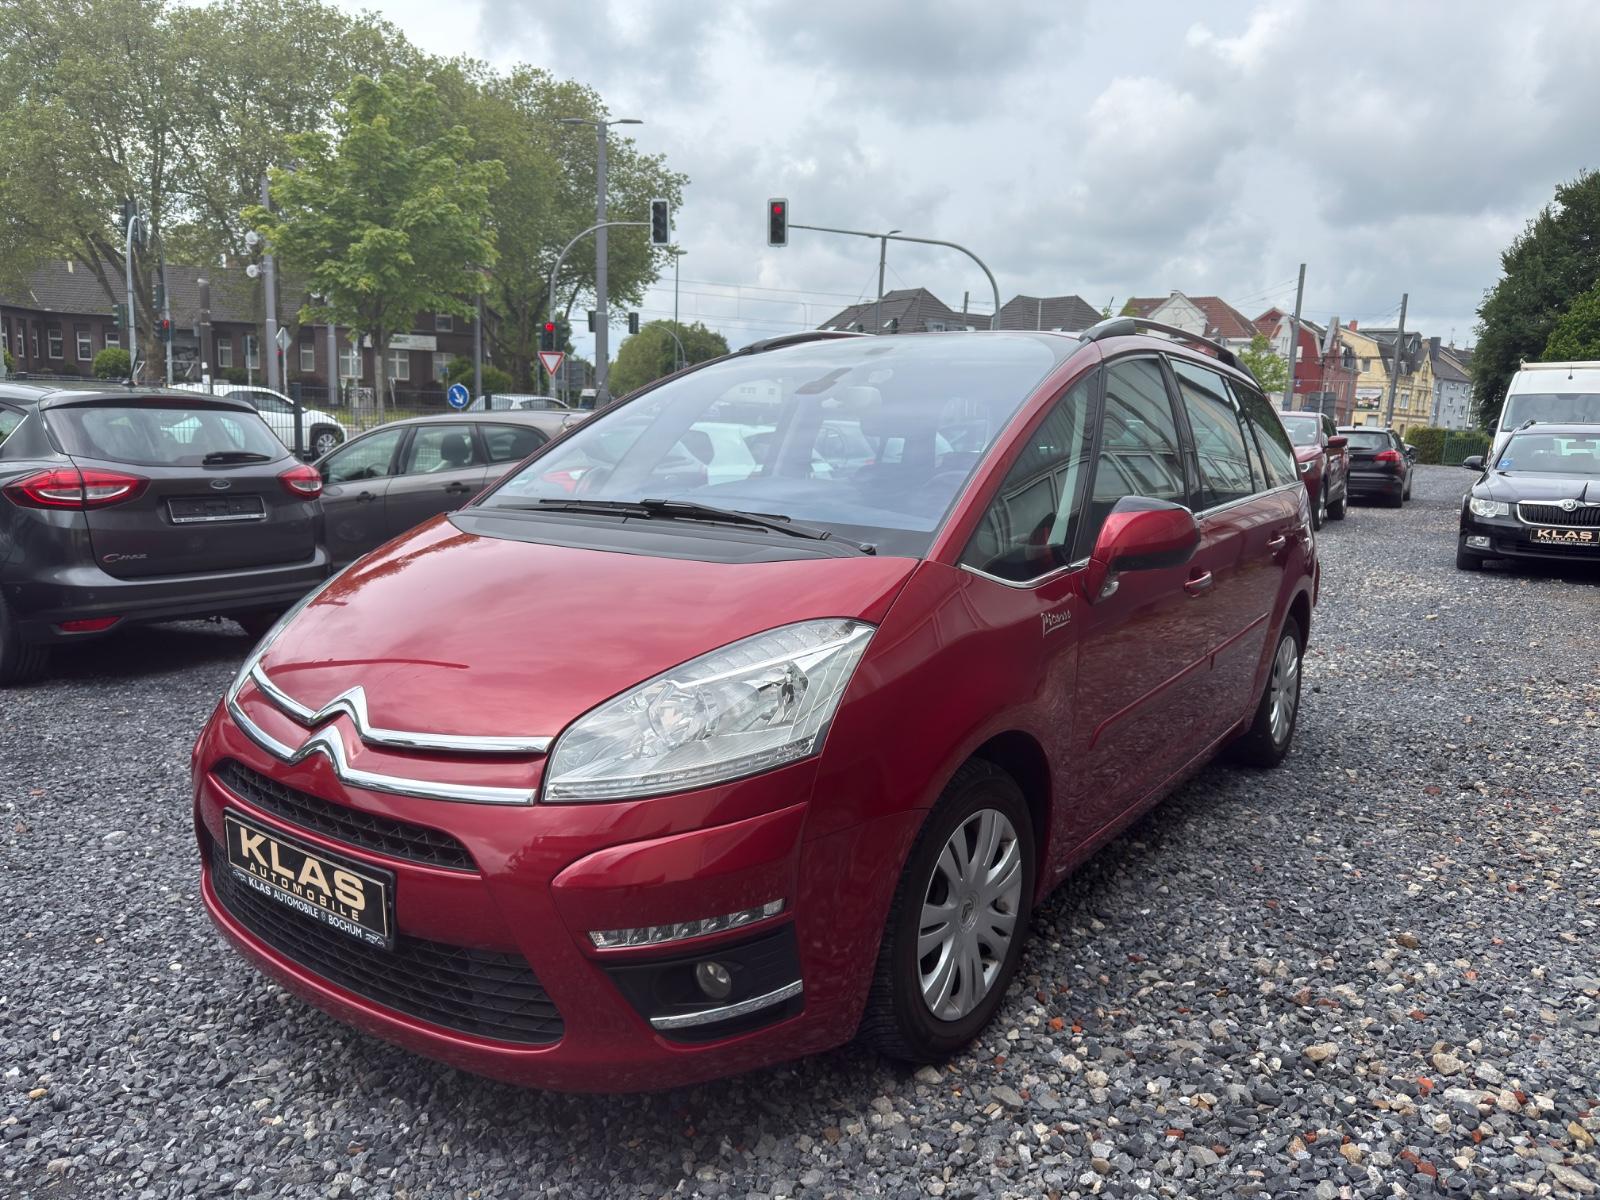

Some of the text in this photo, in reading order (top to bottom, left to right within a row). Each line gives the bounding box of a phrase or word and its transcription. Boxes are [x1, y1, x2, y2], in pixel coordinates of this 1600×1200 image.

[1537, 529, 1593, 540] KLAS
[240, 826, 366, 911] KLAS
[249, 862, 359, 922] AUTOMOBILE
[248, 876, 362, 938] KLAS AUTOMOBILE BOCHUM
